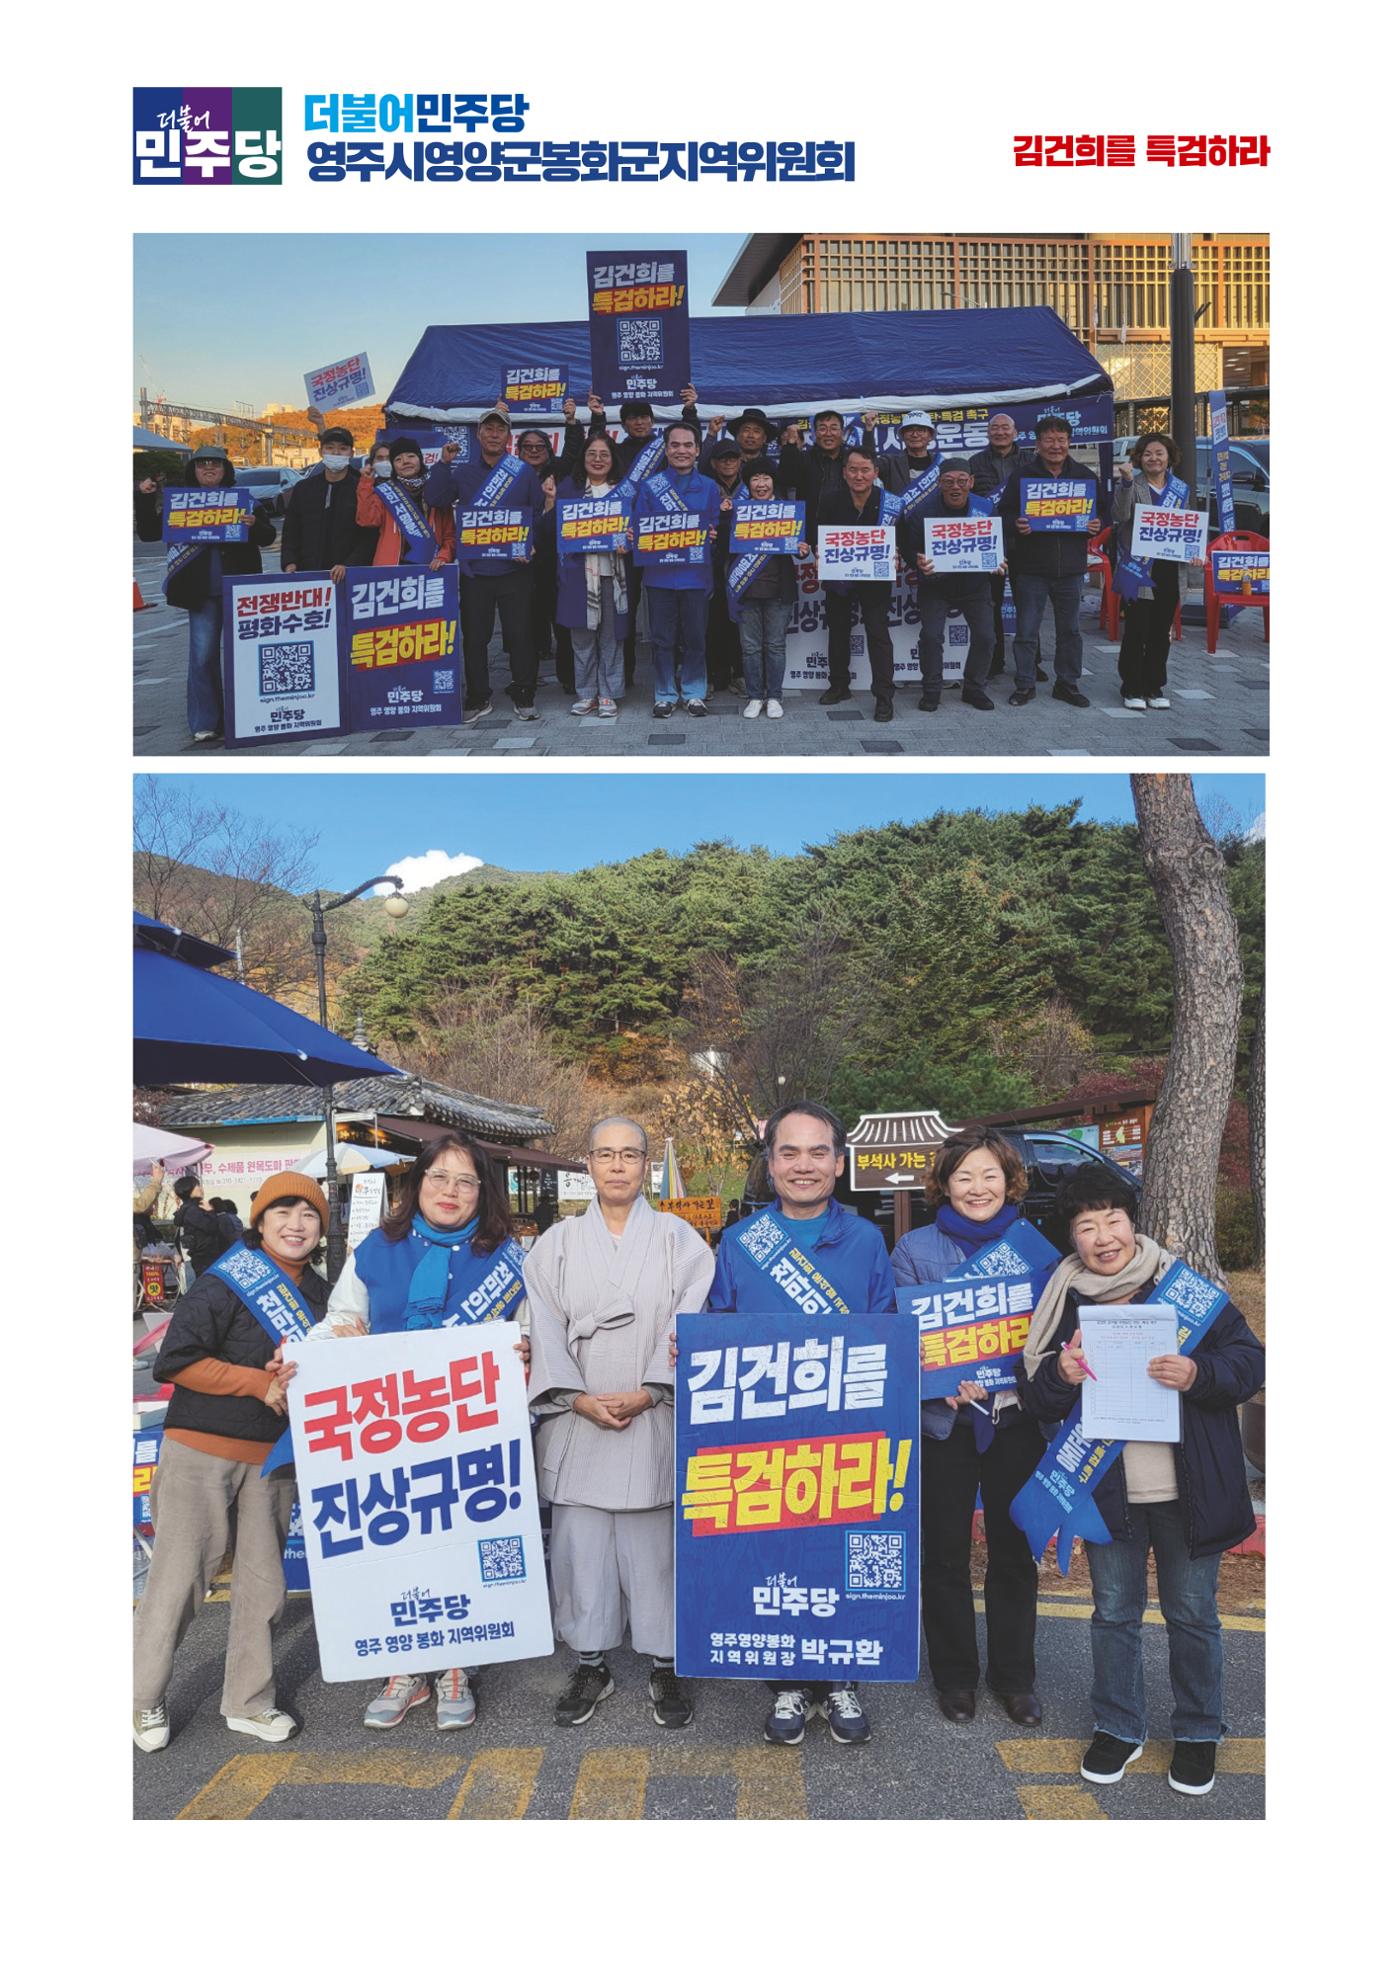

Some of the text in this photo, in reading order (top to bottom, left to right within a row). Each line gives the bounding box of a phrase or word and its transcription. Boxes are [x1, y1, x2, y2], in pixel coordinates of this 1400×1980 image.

[593, 261, 675, 288] 김건희를
[592, 285, 685, 312] 특검하라!
[311, 357, 360, 388] 국정농단
[506, 368, 560, 384] 김건희를
[313, 368, 366, 402] 진상규명!
[505, 382, 566, 400] 특검하라!
[170, 490, 238, 510] 김건희를
[1027, 482, 1086, 500] 김건희를
[562, 500, 622, 520] 김건희를
[736, 504, 796, 522] 김건희를
[1024, 498, 1094, 516] 특검하라!
[168, 508, 246, 528] 특검하라!
[462, 509, 522, 528] 김건희를
[561, 516, 630, 538] 특검하라!
[638, 513, 700, 534] 김건희를
[1141, 511, 1200, 528] 국정농단
[460, 526, 529, 545] 특검하라!
[734, 520, 802, 539] 특검하라!
[825, 529, 886, 546] 국정농단
[932, 520, 992, 538] 국정농단
[1139, 527, 1202, 544] 진상규명!
[638, 530, 707, 552] 특검하라!
[932, 536, 998, 556] 진상규명!
[824, 544, 890, 564] 진상규명!
[237, 587, 332, 618] 전쟁반대!
[351, 575, 445, 620] 김건희를
[238, 608, 332, 641] 평화수호!
[350, 620, 456, 668] 특검하라!
[806, 656, 828, 668] 민주
[387, 690, 424, 704] 민주당
[270, 708, 306, 723] 민주당
[857, 1152, 896, 1170] 부석사
[899, 1150, 926, 1169] 가는
[460, 1260, 514, 1320] 천만인
[770, 1257, 832, 1314] 천만인
[911, 1282, 1033, 1331] 김건희를
[687, 1336, 888, 1425] 김건희를
[304, 1350, 500, 1462] 국정농단
[682, 1438, 912, 1529] 특검하라!
[311, 1438, 522, 1559] 진상규명!
[765, 1572, 798, 1588] 더불어
[400, 1586, 431, 1600] 더불어
[752, 1586, 840, 1618] 민주당
[846, 1592, 906, 1600] sign.theminjoo.kr
[390, 1594, 471, 1627] 민주당
[355, 1620, 515, 1657] 영주 영양 봉화 지역위원회
[710, 1632, 884, 1666] 영주영양봉화 박규환
